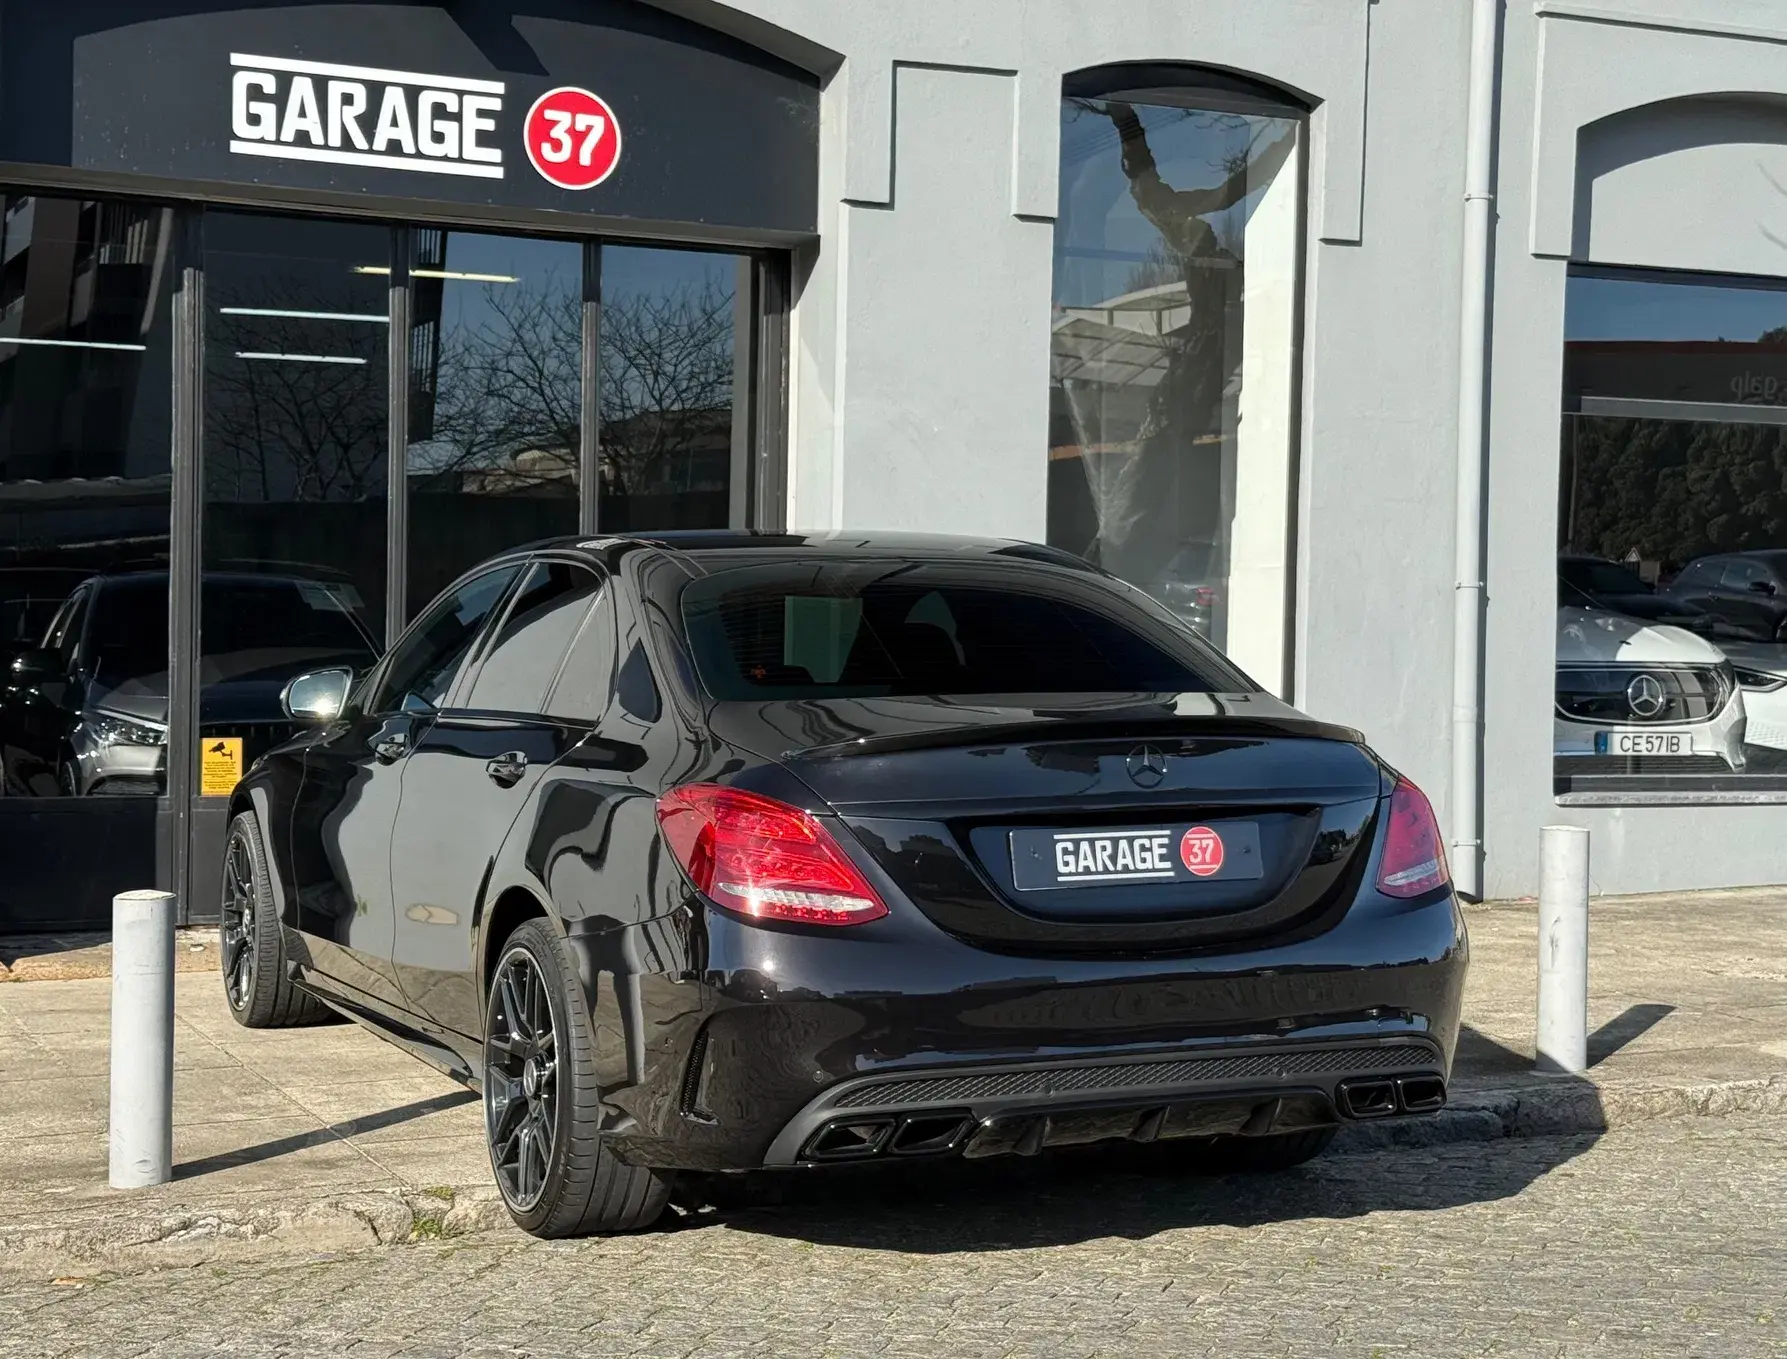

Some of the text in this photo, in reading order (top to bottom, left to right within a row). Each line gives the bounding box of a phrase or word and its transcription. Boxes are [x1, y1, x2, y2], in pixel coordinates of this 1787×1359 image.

[232, 70, 605, 167] GARAGE 37
[1055, 837, 1215, 874] GARAGE 37
